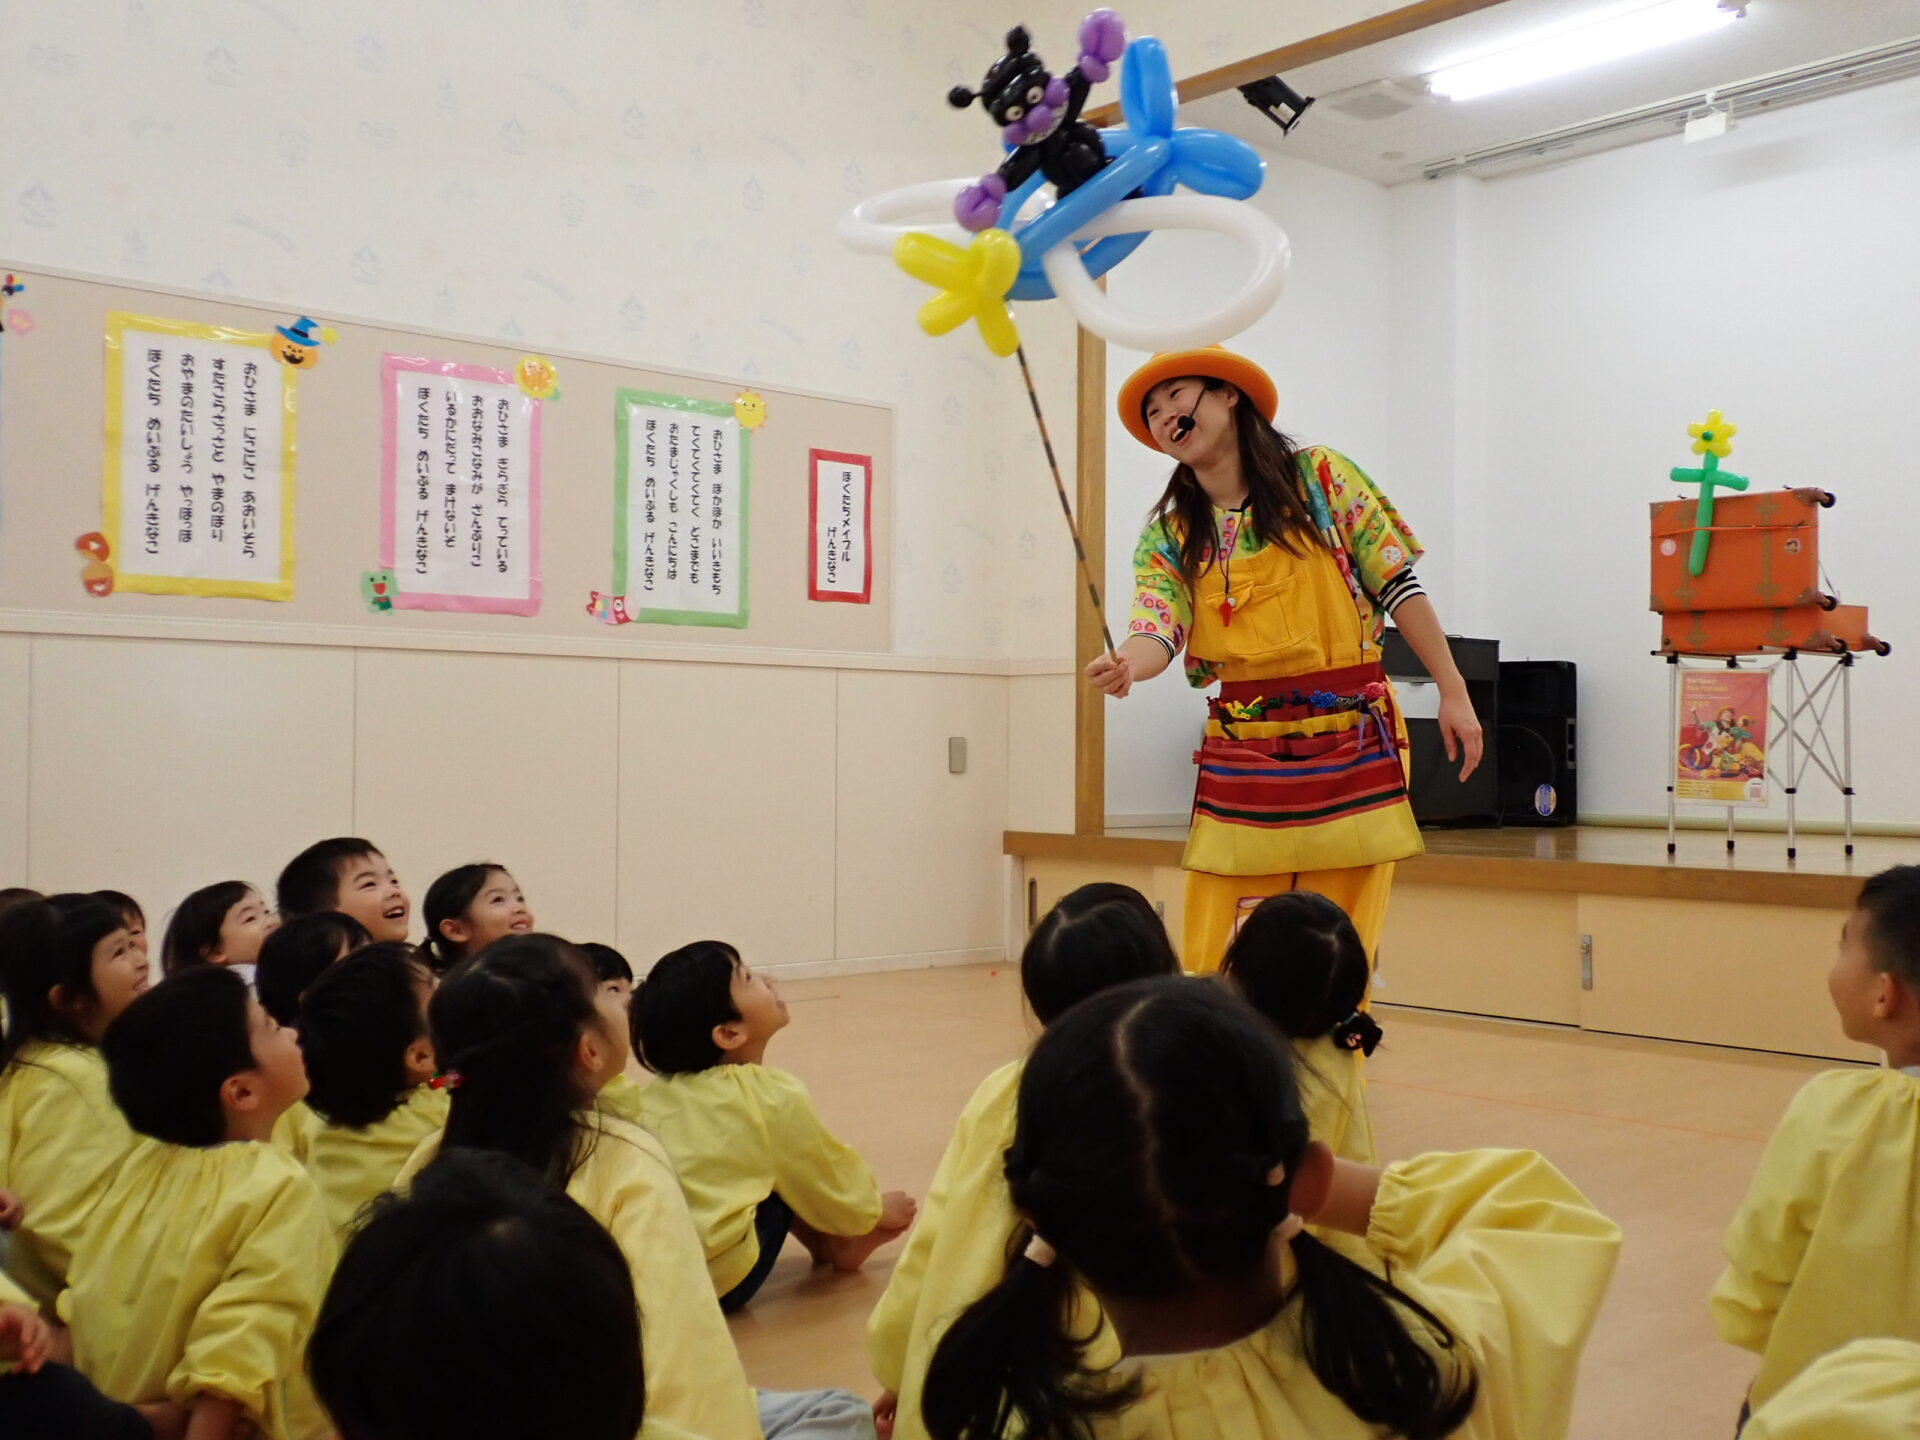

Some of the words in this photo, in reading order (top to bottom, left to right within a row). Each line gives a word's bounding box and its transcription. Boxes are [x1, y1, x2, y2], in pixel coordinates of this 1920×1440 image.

[690, 425, 701, 518] てくてくてくてく
